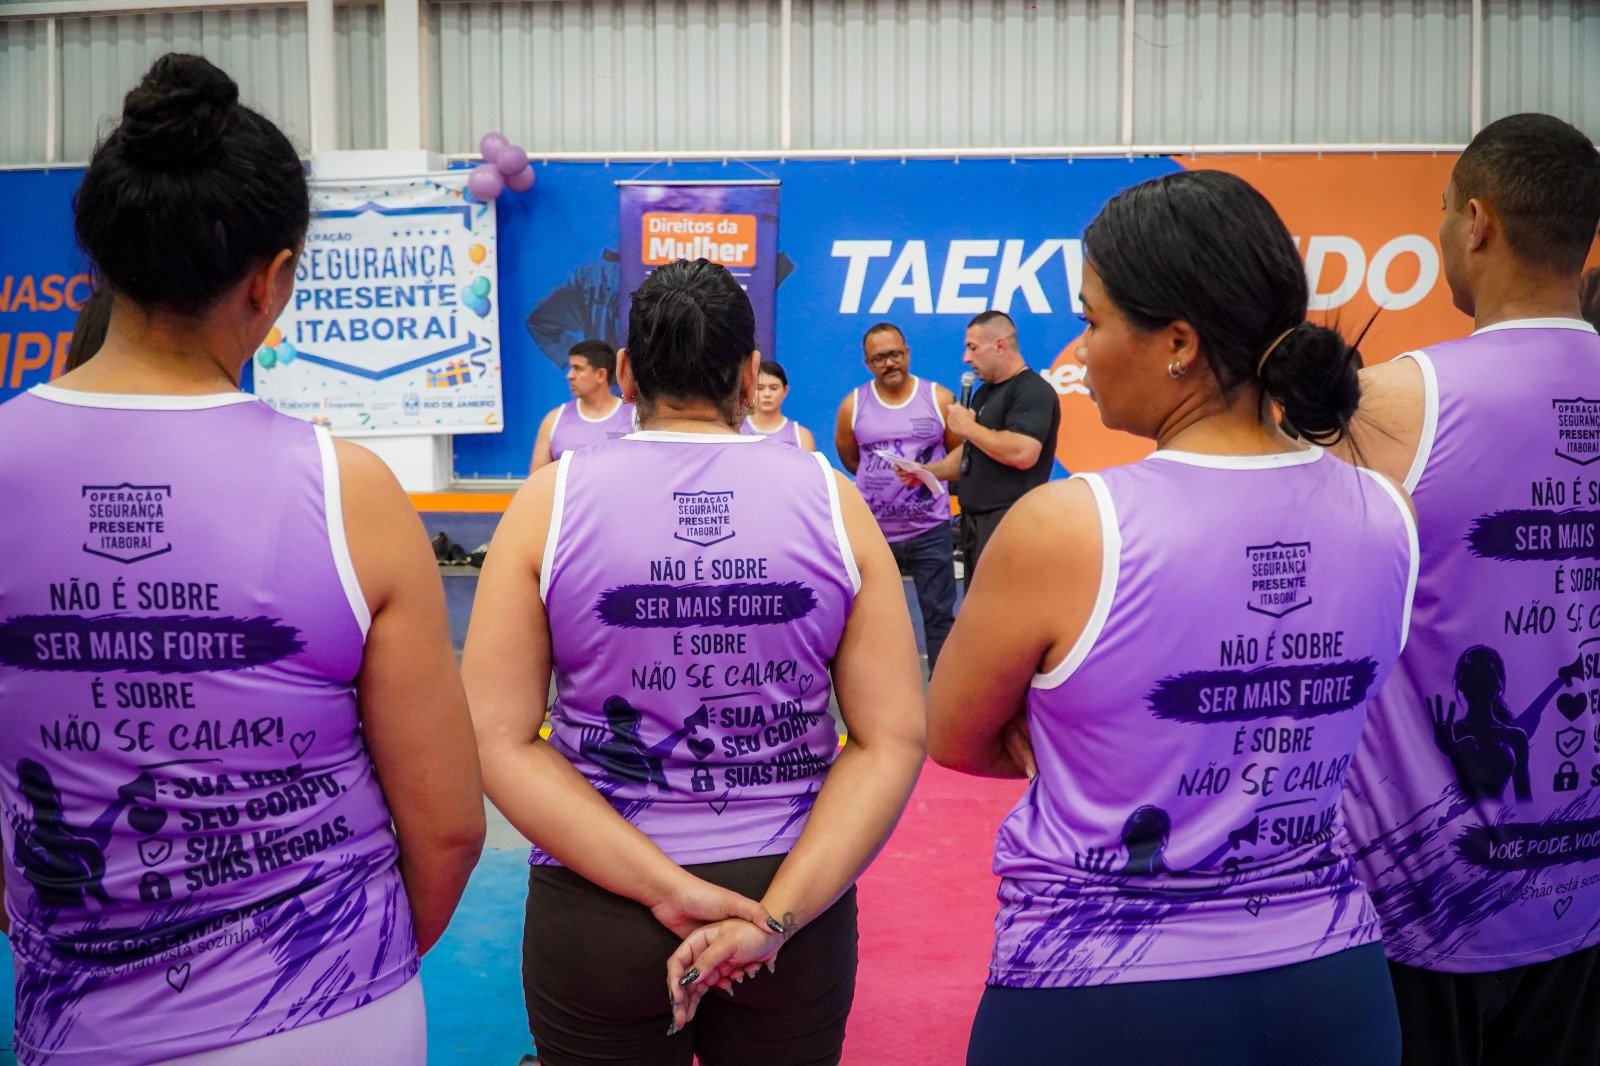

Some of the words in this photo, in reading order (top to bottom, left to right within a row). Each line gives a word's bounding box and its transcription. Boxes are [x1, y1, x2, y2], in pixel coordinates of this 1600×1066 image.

[649, 217, 714, 233] Direitos
[717, 218, 738, 235] da
[649, 236, 749, 262] Mulher
[296, 244, 455, 284] SEGURANÇA
[831, 234, 1440, 313] TAEKDO
[295, 284, 457, 311] PRESENTE
[297, 309, 458, 344] ITABORAÍ
[1558, 404, 1600, 414] OPERAÇÃ
[1567, 441, 1600, 453] ITABORAÍ
[90, 491, 163, 504] OPERAÇÃO
[679, 495, 729, 506] OPERAÇÃO
[1531, 476, 1566, 507] NÃO
[1573, 476, 1582, 505] É
[89, 503, 164, 519] SEGURANÇA
[678, 504, 730, 516] SEGURANÇA
[678, 515, 730, 526] PRESENTE
[89, 521, 164, 533] PRESENTE
[686, 525, 722, 537] ITABORAÍ
[1515, 525, 1551, 551] SER
[1558, 523, 1595, 549] MAIS
[100, 535, 152, 549] ITABORAÍ
[1252, 548, 1306, 563] OPERAÇÃO
[1252, 560, 1307, 577] SEGURANÇA
[650, 557, 686, 582] NÃO
[694, 556, 704, 580] É
[711, 558, 768, 580] SOBRE
[1555, 565, 1565, 594] É
[49, 577, 100, 611] NÃO
[112, 576, 127, 610] É
[137, 582, 219, 611] SOBRE
[1252, 577, 1307, 592] PRESENTE
[635, 598, 670, 620] SER
[676, 596, 722, 618] MAIS
[728, 595, 783, 617] FORTE
[1260, 590, 1297, 606] ITABORAÍ
[1504, 599, 1556, 635] NÃO
[33, 632, 82, 661] SER
[89, 631, 154, 660] MAIS
[163, 631, 246, 660] FORTE
[673, 631, 684, 656] É
[690, 633, 747, 656] SOBRE
[1220, 635, 1259, 667] NÃO
[1265, 631, 1276, 662] É
[1281, 631, 1344, 660] SOBRE
[631, 661, 677, 692] NÃO
[685, 663, 716, 689] SE
[724, 660, 798, 688] CALAR!
[91, 677, 107, 709] É
[115, 681, 196, 709] SOBRE
[1197, 685, 1238, 714] SER
[1243, 678, 1292, 710] MAIS
[1299, 675, 1354, 706] FORTE
[720, 705, 767, 729] SUA
[39, 714, 101, 752] NÃO
[114, 718, 156, 752] SE
[168, 716, 285, 752] CALAR!
[721, 733, 761, 758] SEU
[1233, 726, 1247, 756] É
[1250, 727, 1315, 754] SOBRE
[171, 773, 238, 800] SUA
[724, 764, 773, 789] SUAS
[1177, 761, 1231, 797] NÃO
[1241, 762, 1280, 797] SE
[179, 805, 240, 832] SEU
[1270, 814, 1316, 847] SUA
[184, 849, 254, 891] SUAS
[255, 815, 355, 874] REGRAS.
[1527, 835, 1572, 855] PODE.
[1556, 874, 1579, 894] está
